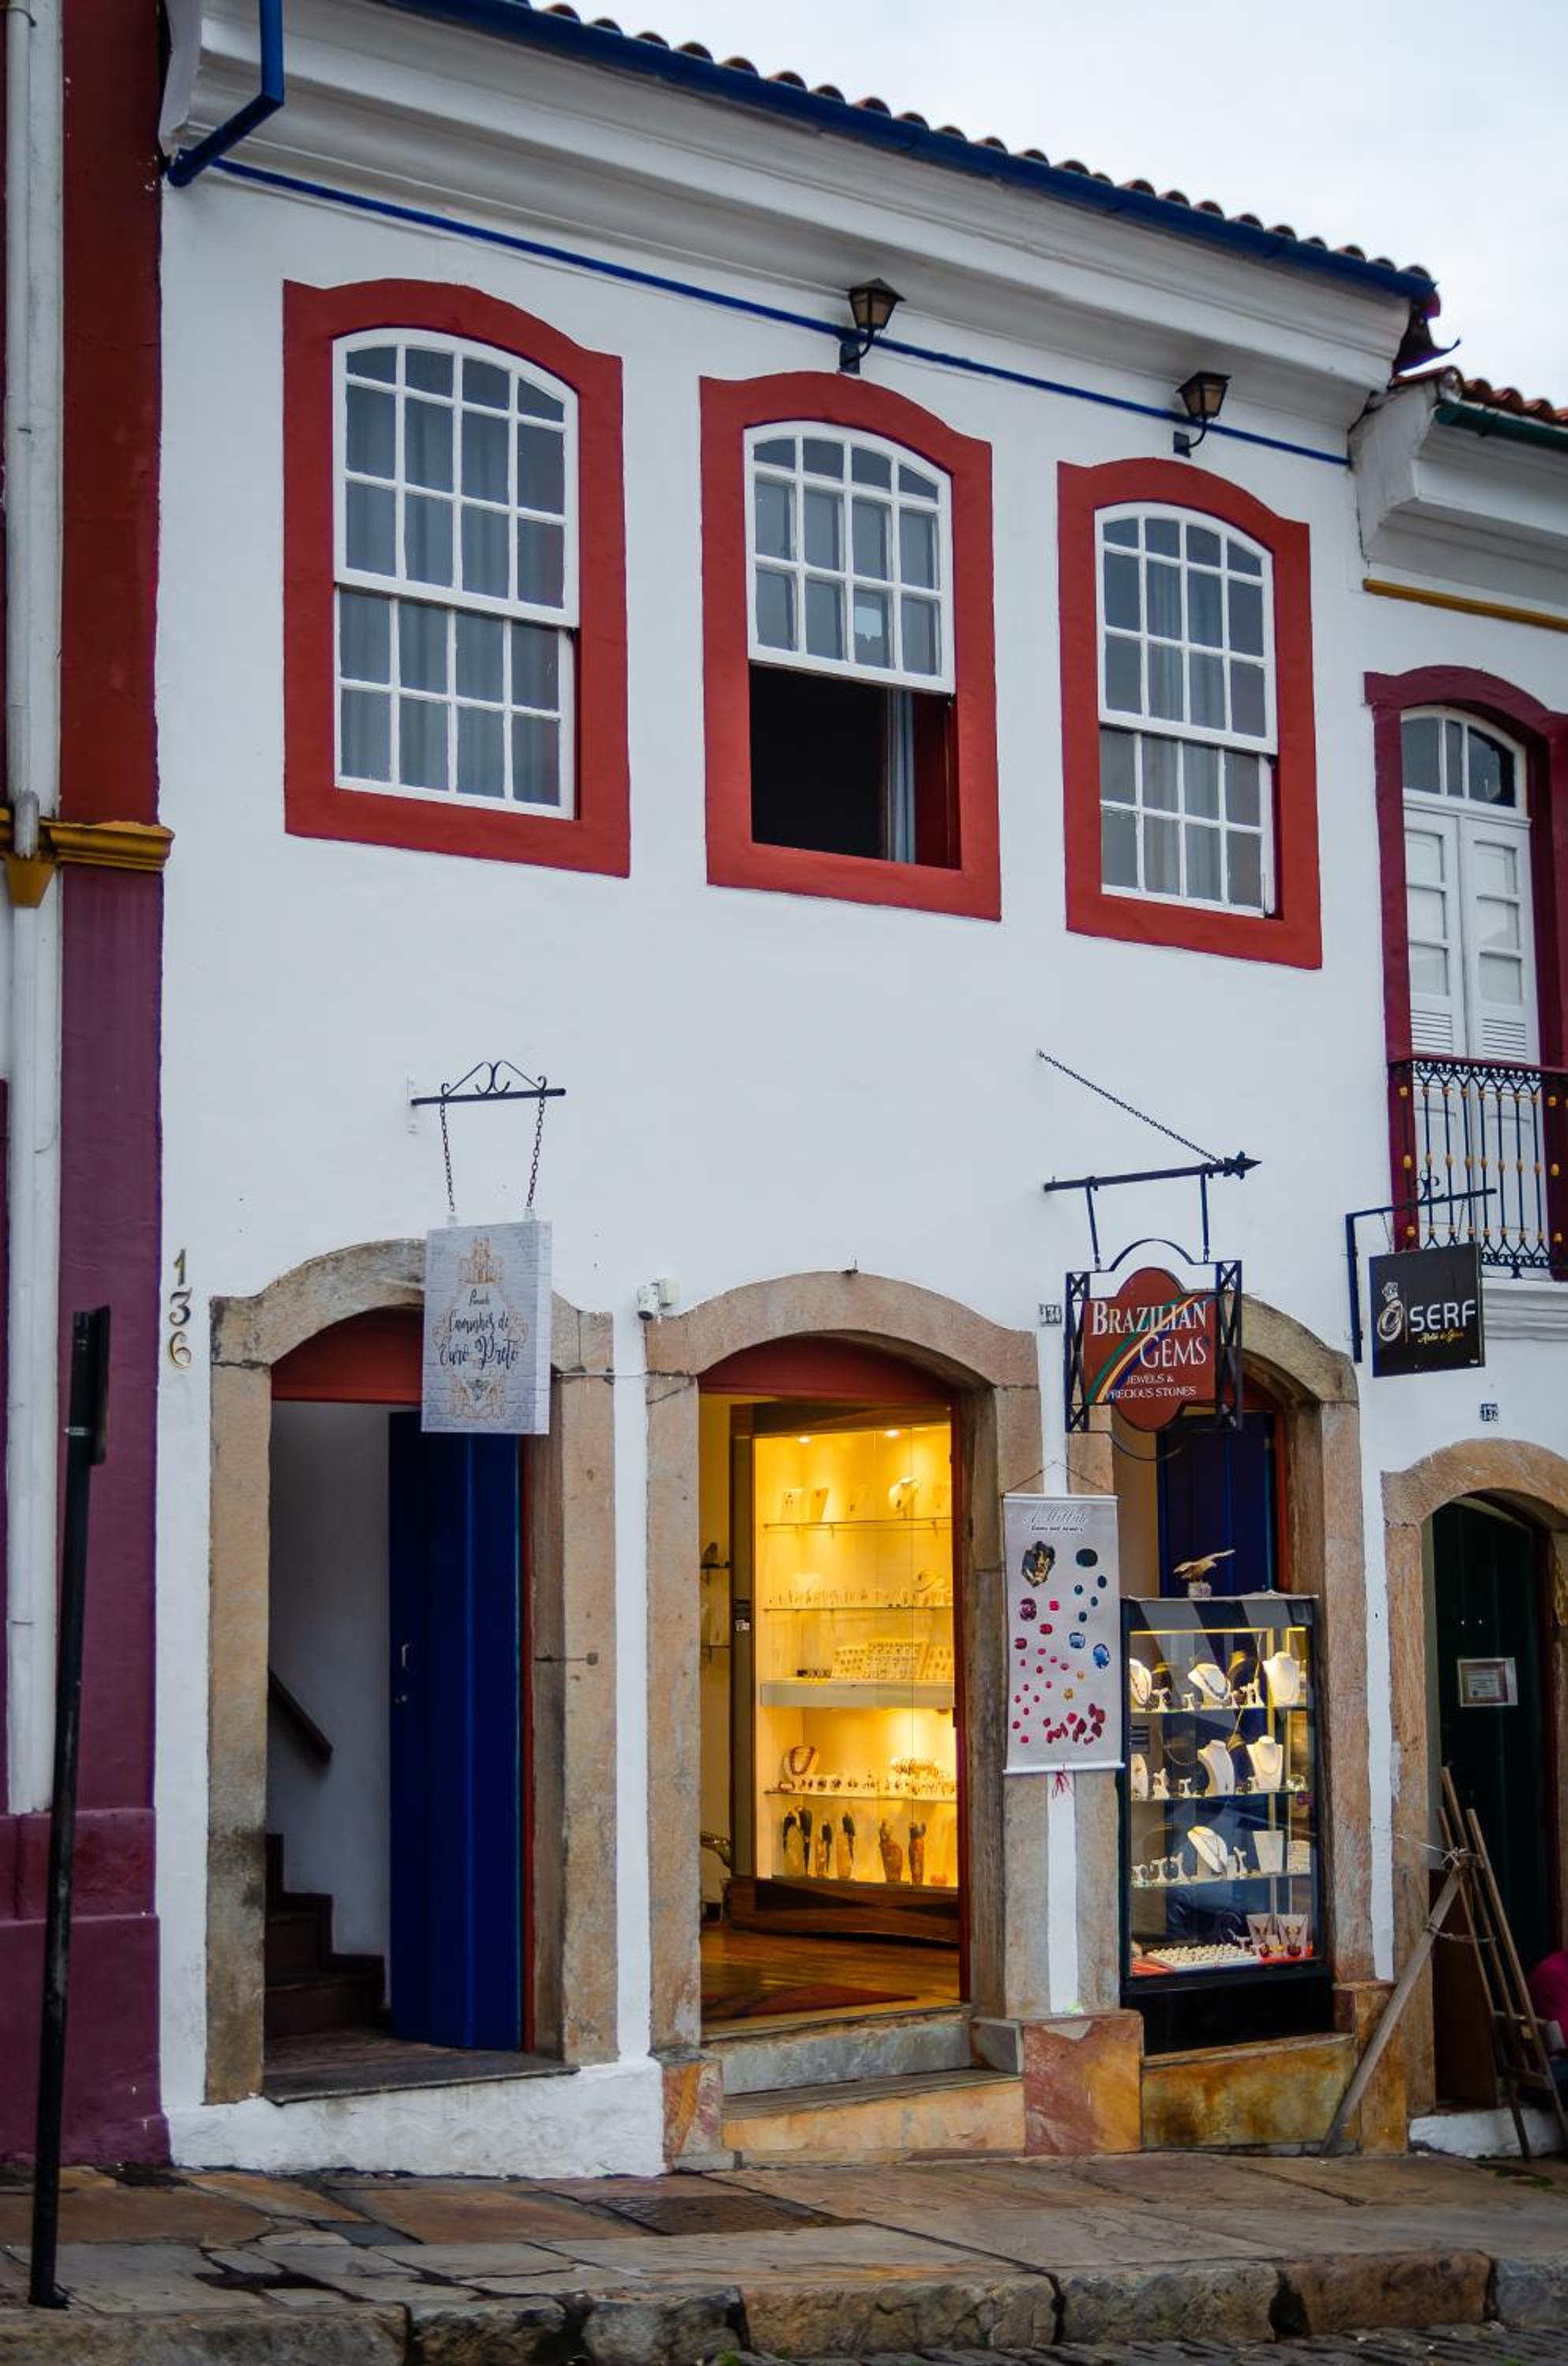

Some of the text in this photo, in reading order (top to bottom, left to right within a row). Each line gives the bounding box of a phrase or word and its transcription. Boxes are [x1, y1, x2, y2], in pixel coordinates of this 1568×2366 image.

[168, 1248, 192, 1369] 136
[1092, 1301, 1208, 1335] BRAZILIAN
[1409, 1299, 1476, 1332] SERF
[474, 1334, 520, 1371] Preto
[1140, 1334, 1207, 1368] GEMS
[1126, 1374, 1174, 1385] JEWELS &
[1155, 1386, 1197, 1397] STONES
